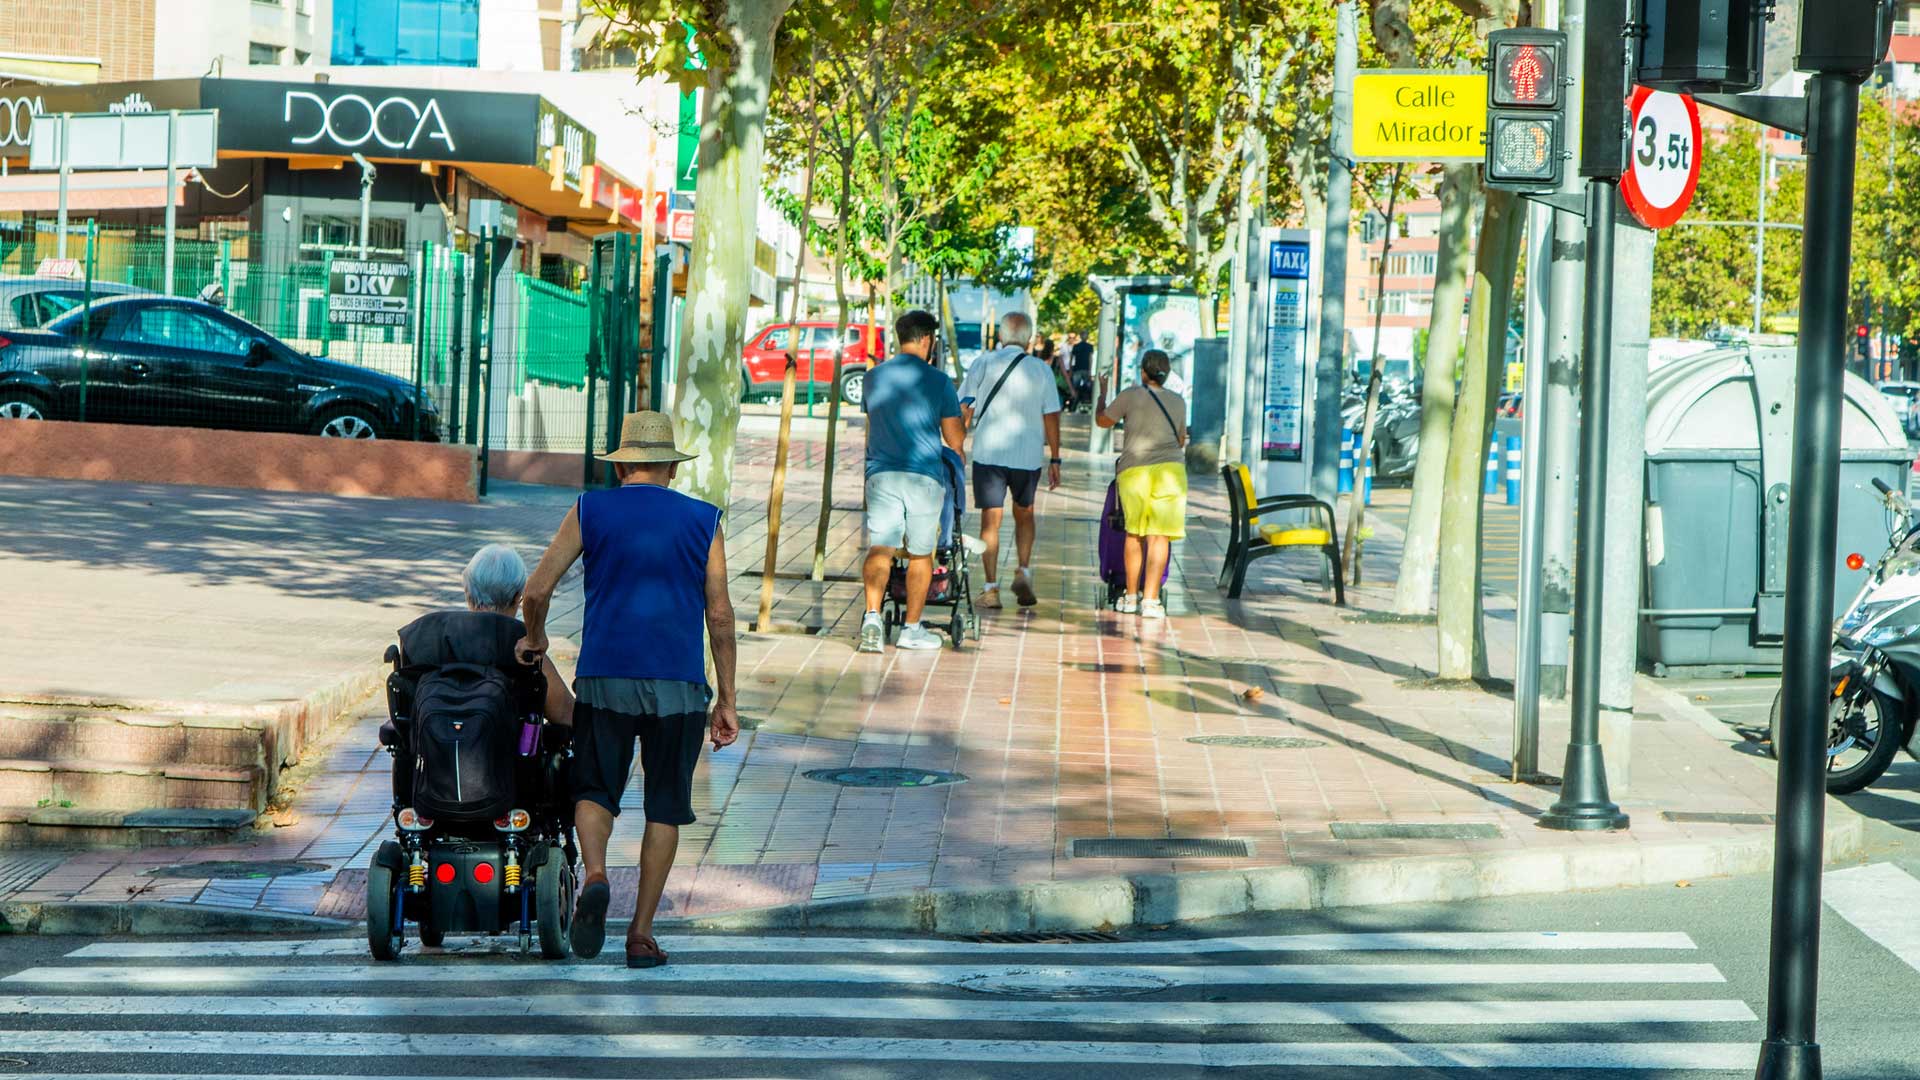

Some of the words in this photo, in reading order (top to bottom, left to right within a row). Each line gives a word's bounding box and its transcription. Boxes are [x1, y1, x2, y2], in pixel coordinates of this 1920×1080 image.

[1395, 85, 1455, 108] Calle
[285, 91, 456, 152] DOCA
[1376, 120, 1473, 143] Mirador
[331, 261, 378, 274] AUTOMOVILES
[379, 263, 408, 276] JUANITO
[1274, 250, 1305, 269] TAXI
[344, 274, 395, 295] DKV
[355, 298, 361, 308] EN
[362, 298, 383, 310] FRENTE
